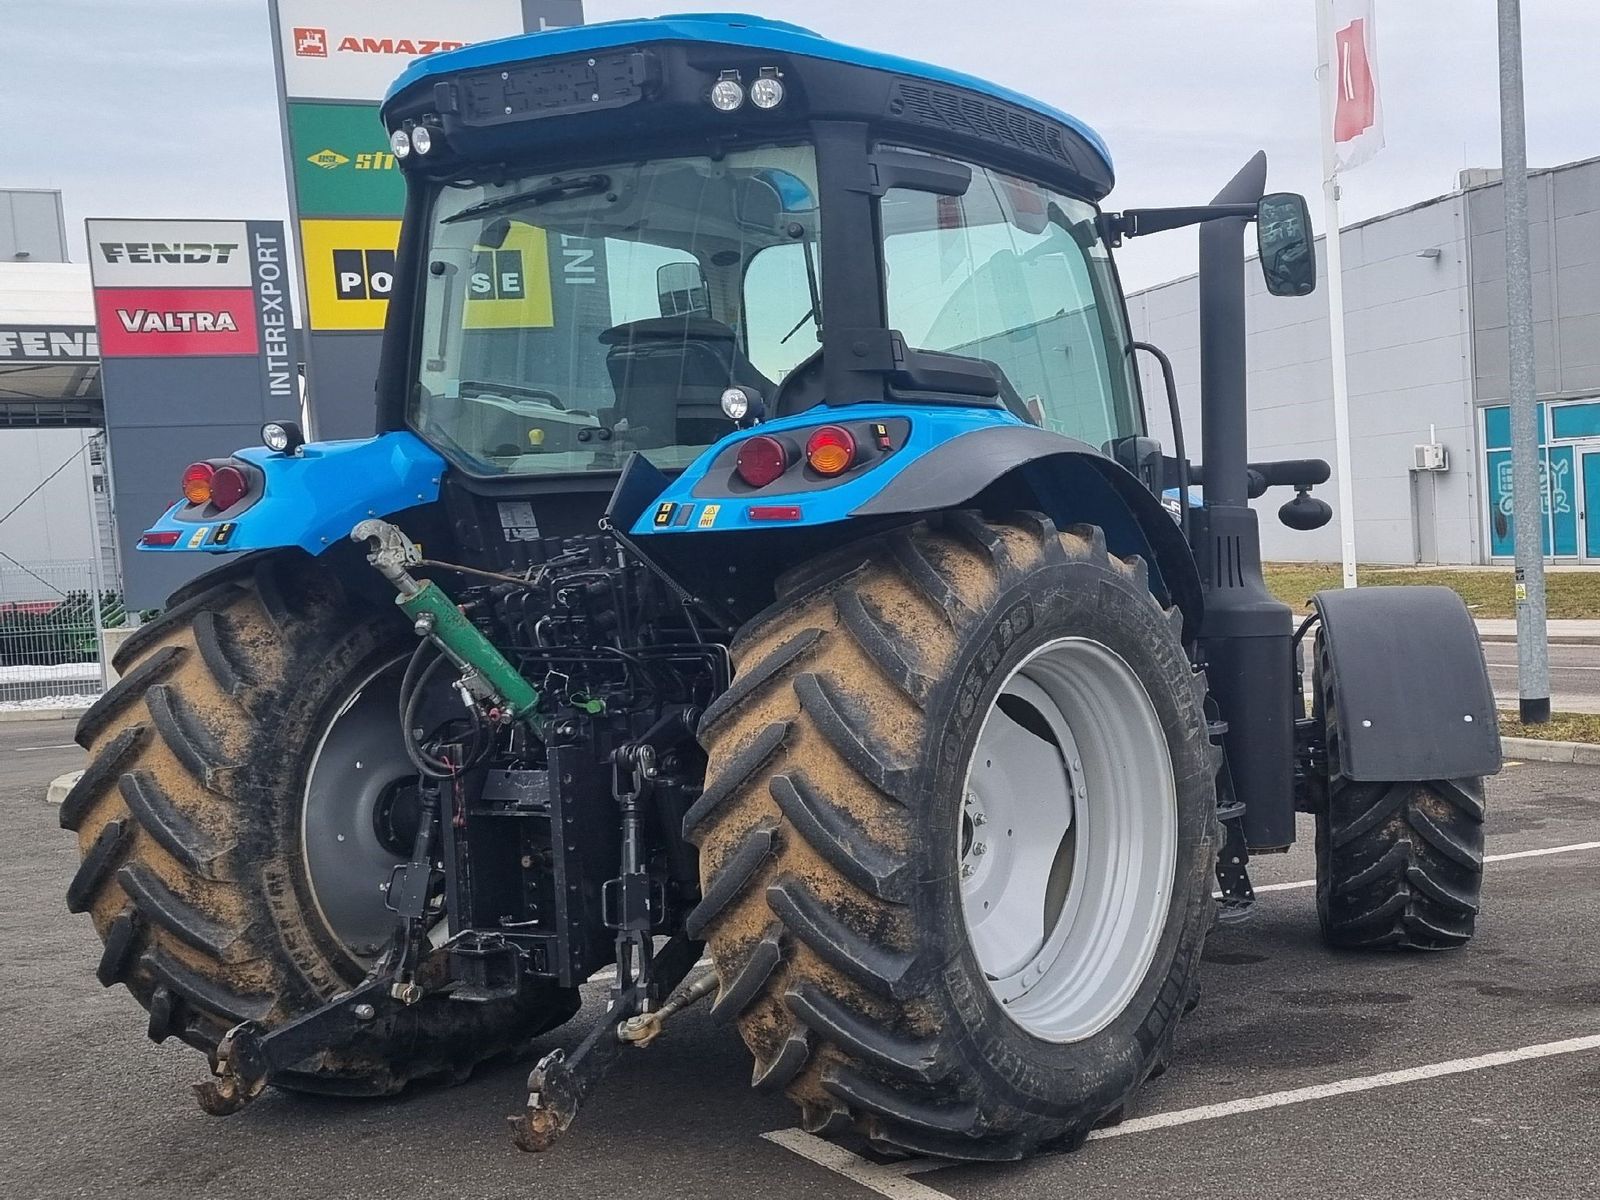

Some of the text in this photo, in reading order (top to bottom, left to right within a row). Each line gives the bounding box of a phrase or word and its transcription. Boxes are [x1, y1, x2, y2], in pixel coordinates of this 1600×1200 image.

[99, 242, 239, 264] FENDT
[115, 308, 240, 334] VALTRA
[255, 232, 292, 396] INTEREXPORT
